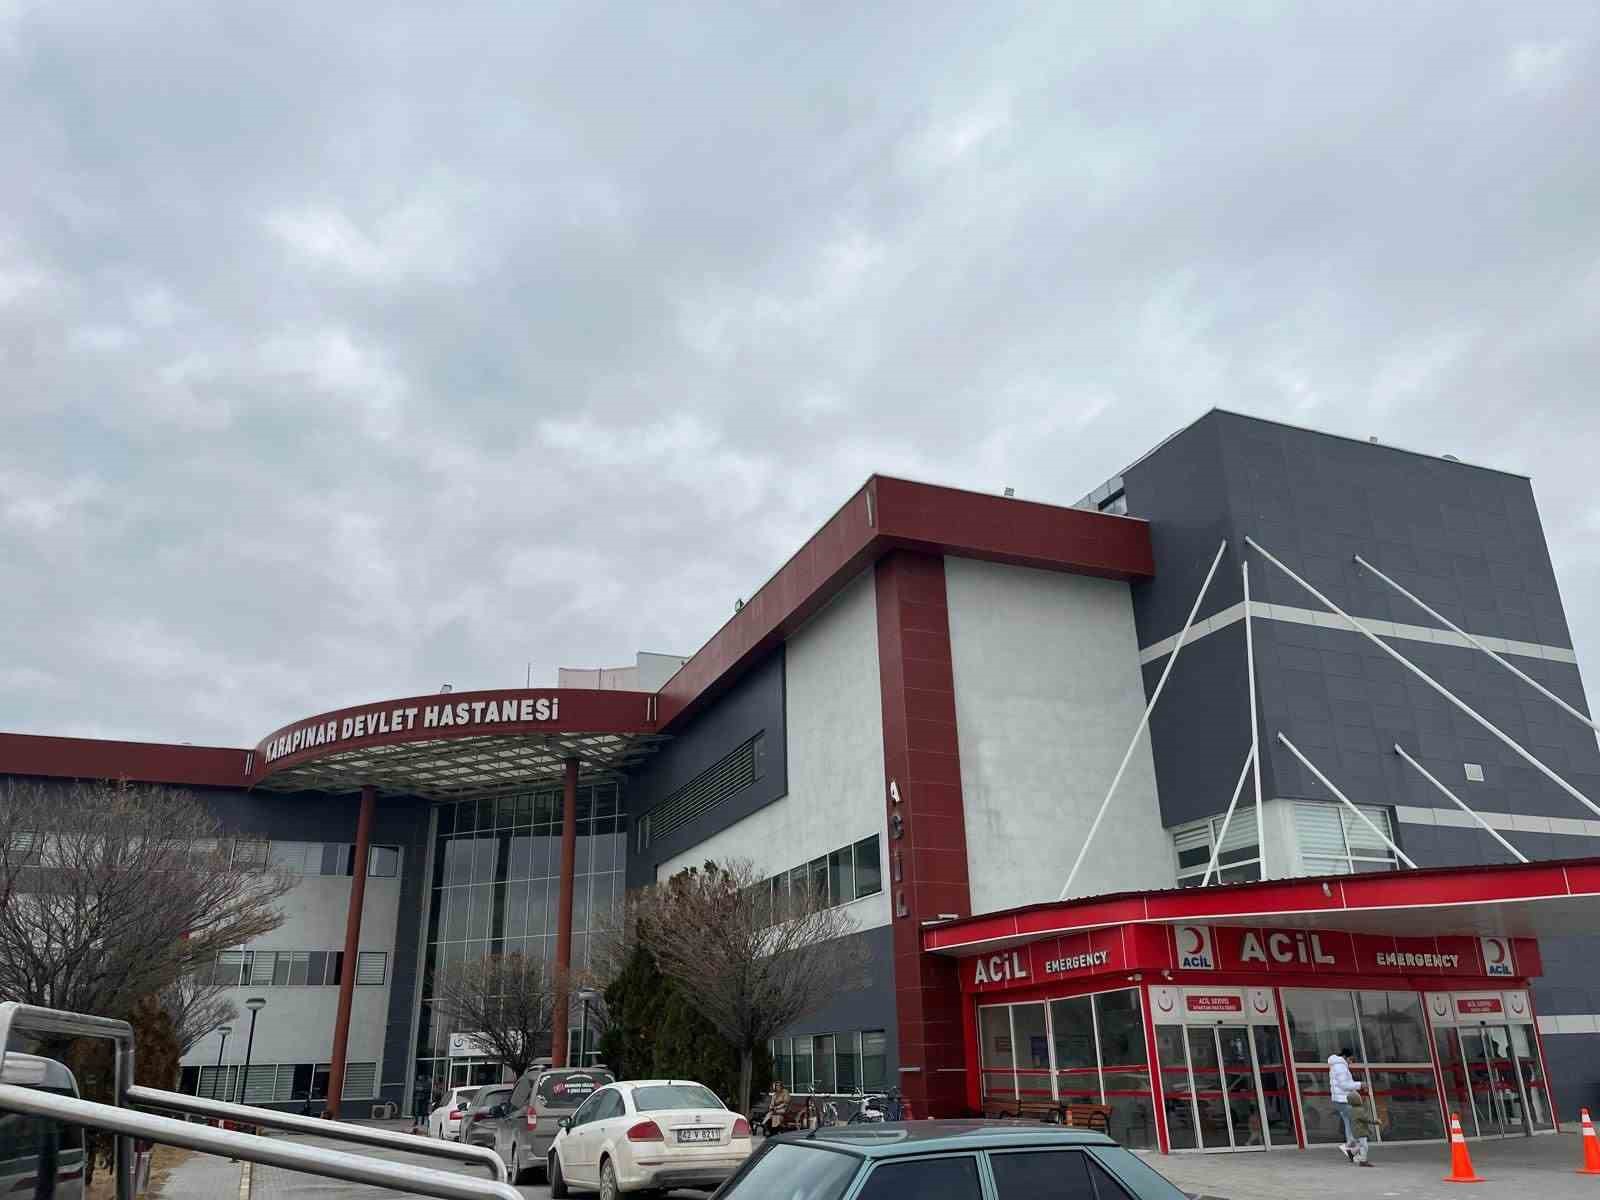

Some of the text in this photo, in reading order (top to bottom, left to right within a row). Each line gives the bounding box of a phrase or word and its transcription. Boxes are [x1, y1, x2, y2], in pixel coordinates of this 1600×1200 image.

[342, 707, 418, 740] DEVLET
[1045, 951, 1108, 973] EMERGENCY
[1376, 952, 1459, 968] EMERGENCY
